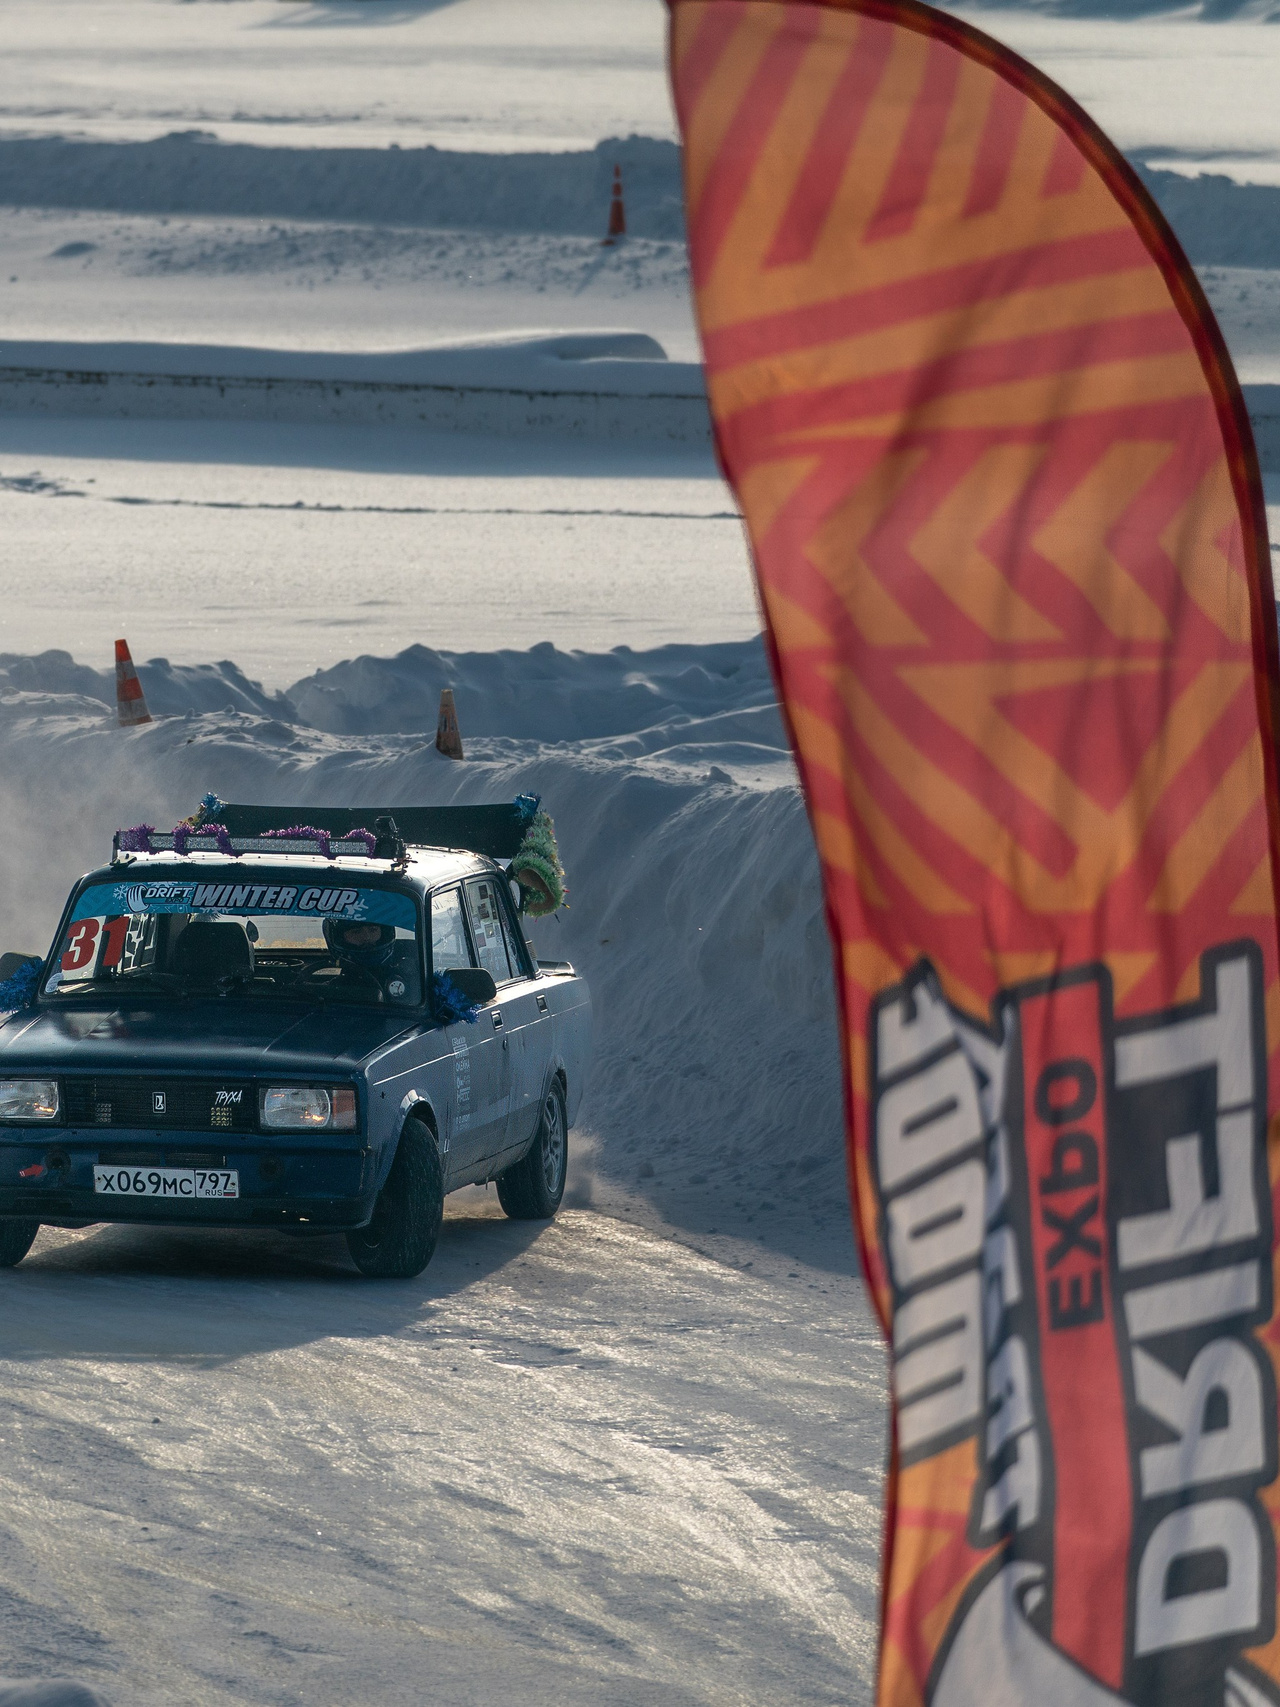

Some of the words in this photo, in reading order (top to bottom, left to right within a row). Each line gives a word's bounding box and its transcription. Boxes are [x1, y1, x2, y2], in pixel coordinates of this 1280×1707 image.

[145, 887, 193, 898] DRIFT
[191, 884, 297, 909] WINTER
[299, 887, 358, 912] CUP
[61, 916, 130, 970] 31
[214, 1090, 243, 1106] ТРУХА
[196, 1172, 231, 1191] 797
